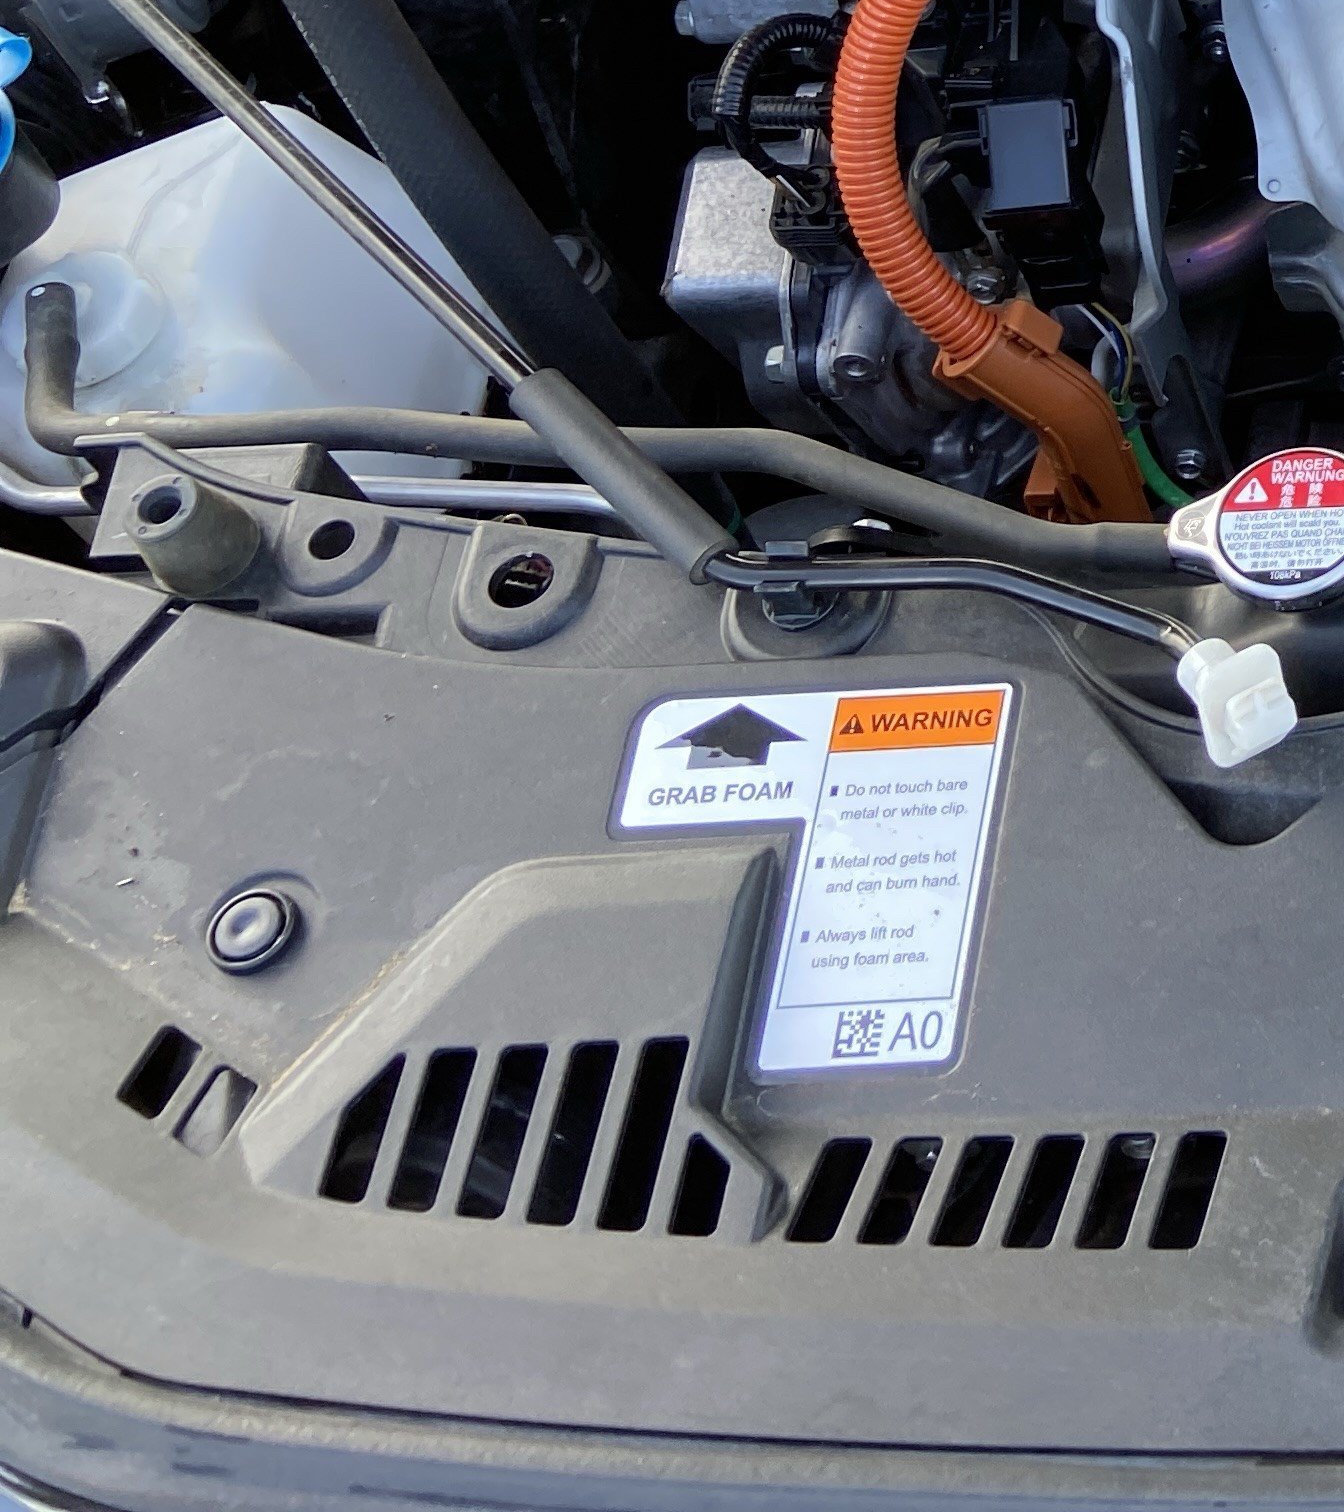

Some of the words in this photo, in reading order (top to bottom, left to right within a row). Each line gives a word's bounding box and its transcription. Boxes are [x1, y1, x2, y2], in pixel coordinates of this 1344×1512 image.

[1272, 458, 1334, 473] DANGER
[1234, 522, 1250, 530] Hot
[1251, 521, 1282, 529] coolant
[1284, 520, 1297, 528] will
[1300, 519, 1321, 527] scald
[1235, 513, 1268, 521] NEVER
[1270, 512, 1296, 520] OPEN
[1299, 510, 1328, 518] WHEN
[1271, 530, 1289, 538] PAS
[1290, 528, 1322, 538] QUAND
[1227, 542, 1248, 550] NICHT
[1250, 541, 1262, 550] BEI
[1262, 540, 1294, 549] HEISSEM
[1295, 538, 1319, 547] MOTOR
[870, 708, 993, 733] WARNING
[647, 784, 717, 806] GRAB
[723, 781, 794, 803] FOAM
[845, 783, 865, 797] Do
[868, 782, 892, 796] not
[895, 780, 933, 795] touch
[936, 778, 968, 792] bare
[840, 806, 879, 820] metal
[882, 805, 898, 818] or
[901, 803, 938, 817] white
[940, 801, 968, 817] clip.
[830, 854, 870, 869] Metal
[873, 852, 897, 867] rod
[900, 851, 930, 869] gets
[934, 849, 957, 863] hot
[825, 880, 853, 894] and
[856, 880, 882, 893] can
[885, 877, 917, 891] burn
[921, 873, 961, 888] hand.
[814, 928, 867, 945] Always
[870, 926, 888, 941] lift
[890, 925, 914, 939] rod
[811, 953, 849, 970] using
[853, 950, 890, 966] foam
[893, 950, 929, 964] area.
[888, 1011, 943, 1052] A0
